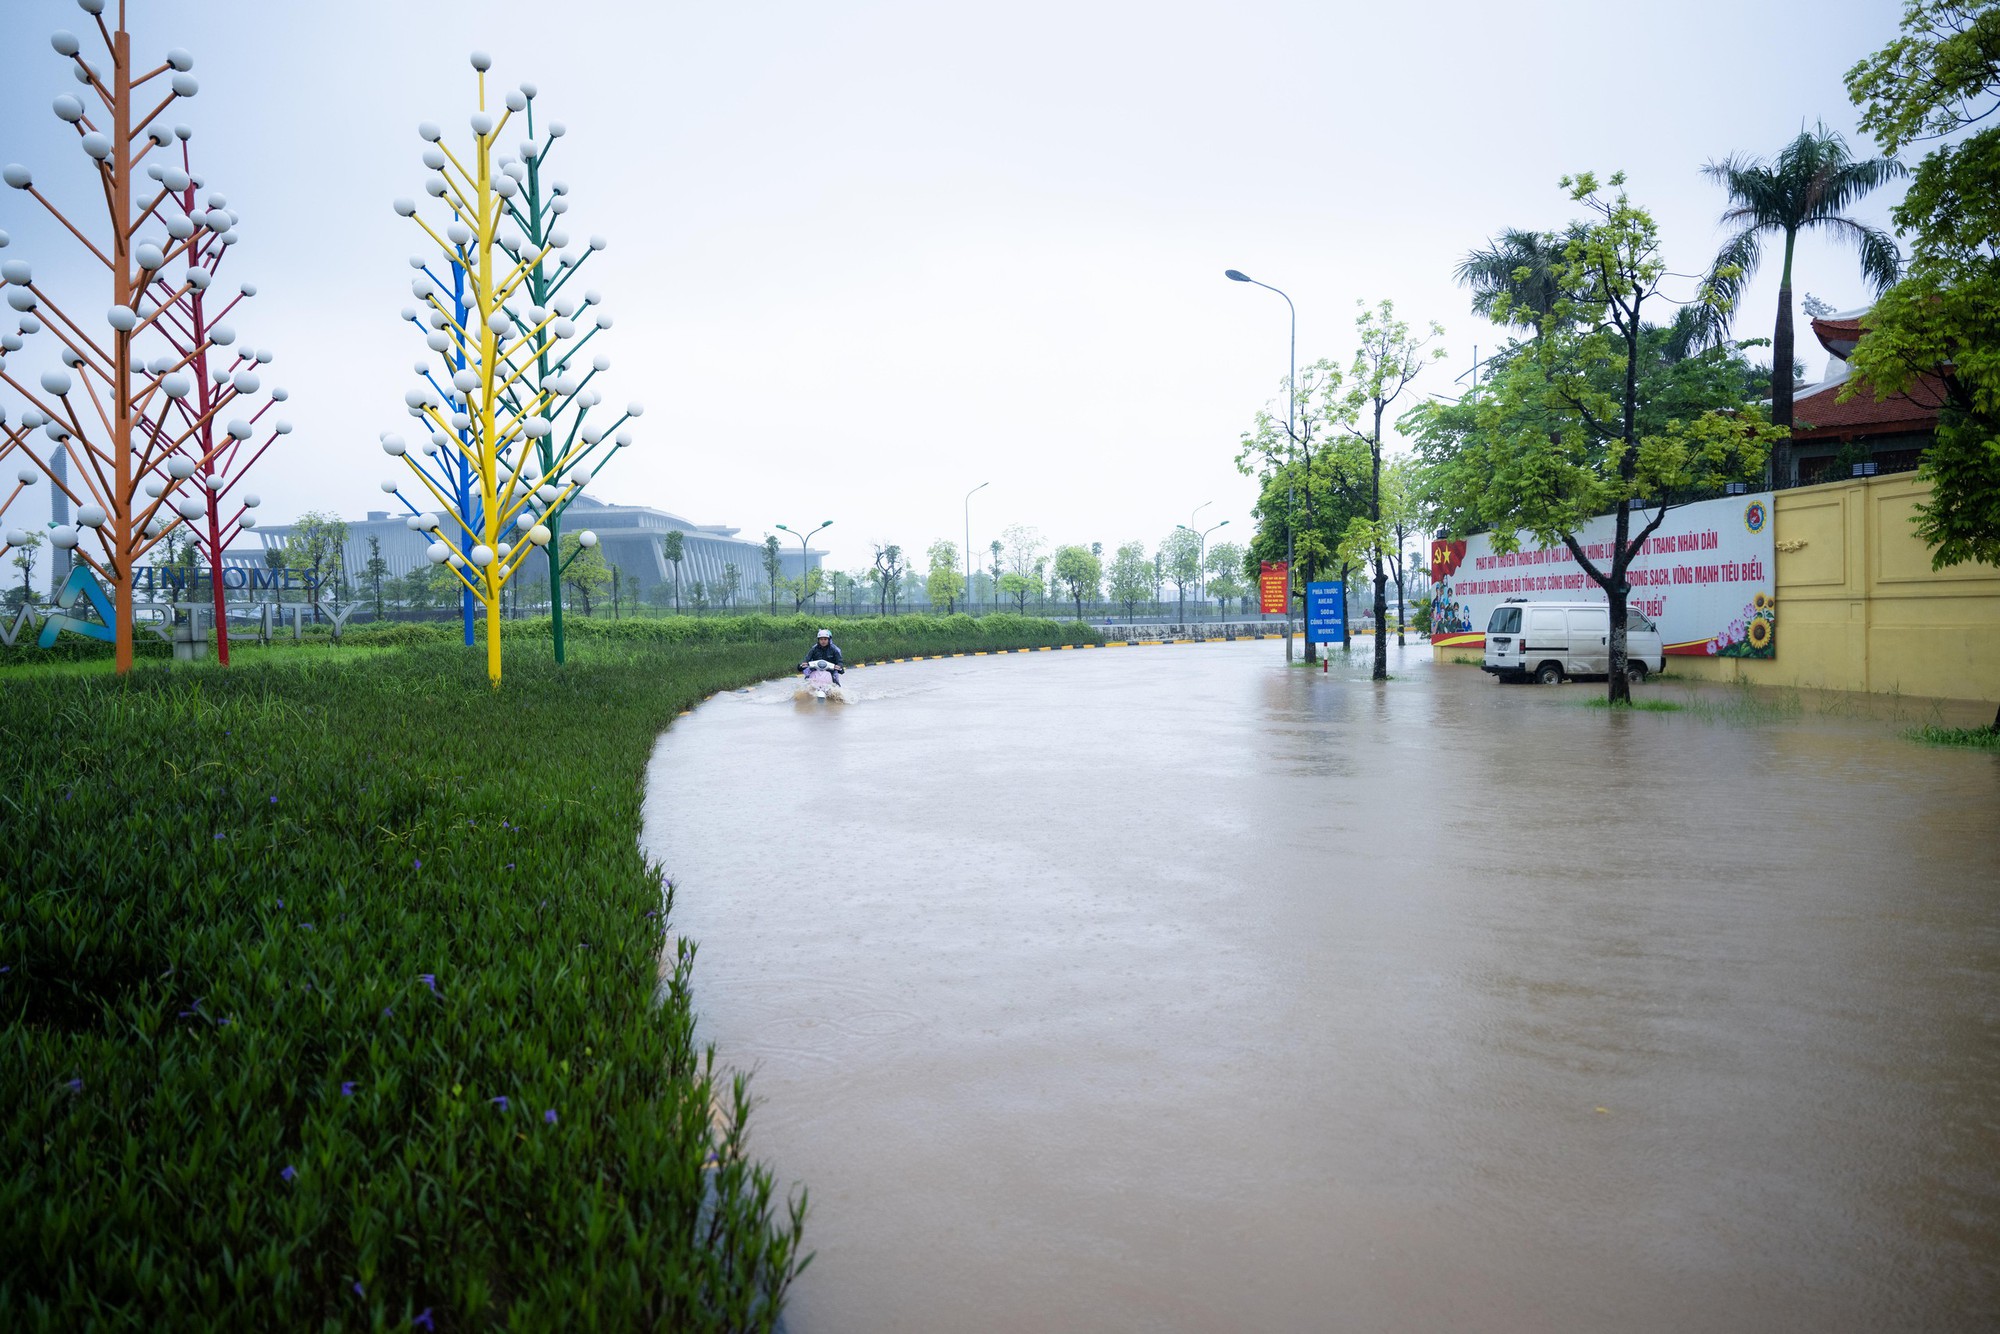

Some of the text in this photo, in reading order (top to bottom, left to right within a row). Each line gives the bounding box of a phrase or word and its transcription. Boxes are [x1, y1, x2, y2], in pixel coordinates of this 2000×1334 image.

[1476, 554, 1487, 570] PHÁT
[1488, 556, 1496, 569] HUY
[1552, 548, 1561, 562] HAI
[1588, 541, 1604, 560] HÙNG
[1652, 536, 1675, 555] TRANG
[1678, 530, 1699, 552] NHÂN
[1701, 528, 1718, 550] DÂN
[1469, 579, 1477, 595] TÂM
[1478, 579, 1486, 595] XÂY
[1548, 572, 1562, 590] CÔNG
[1564, 571, 1584, 592] NGHIỆP
[1625, 569, 1648, 587] TRONG
[1650, 568, 1671, 589] SẠCH,
[1673, 564, 1693, 585] VỮNG
[1695, 565, 1719, 587] MẠNH
[1721, 560, 1739, 582] TIÊU
[1742, 555, 1765, 583] BIỂU,
